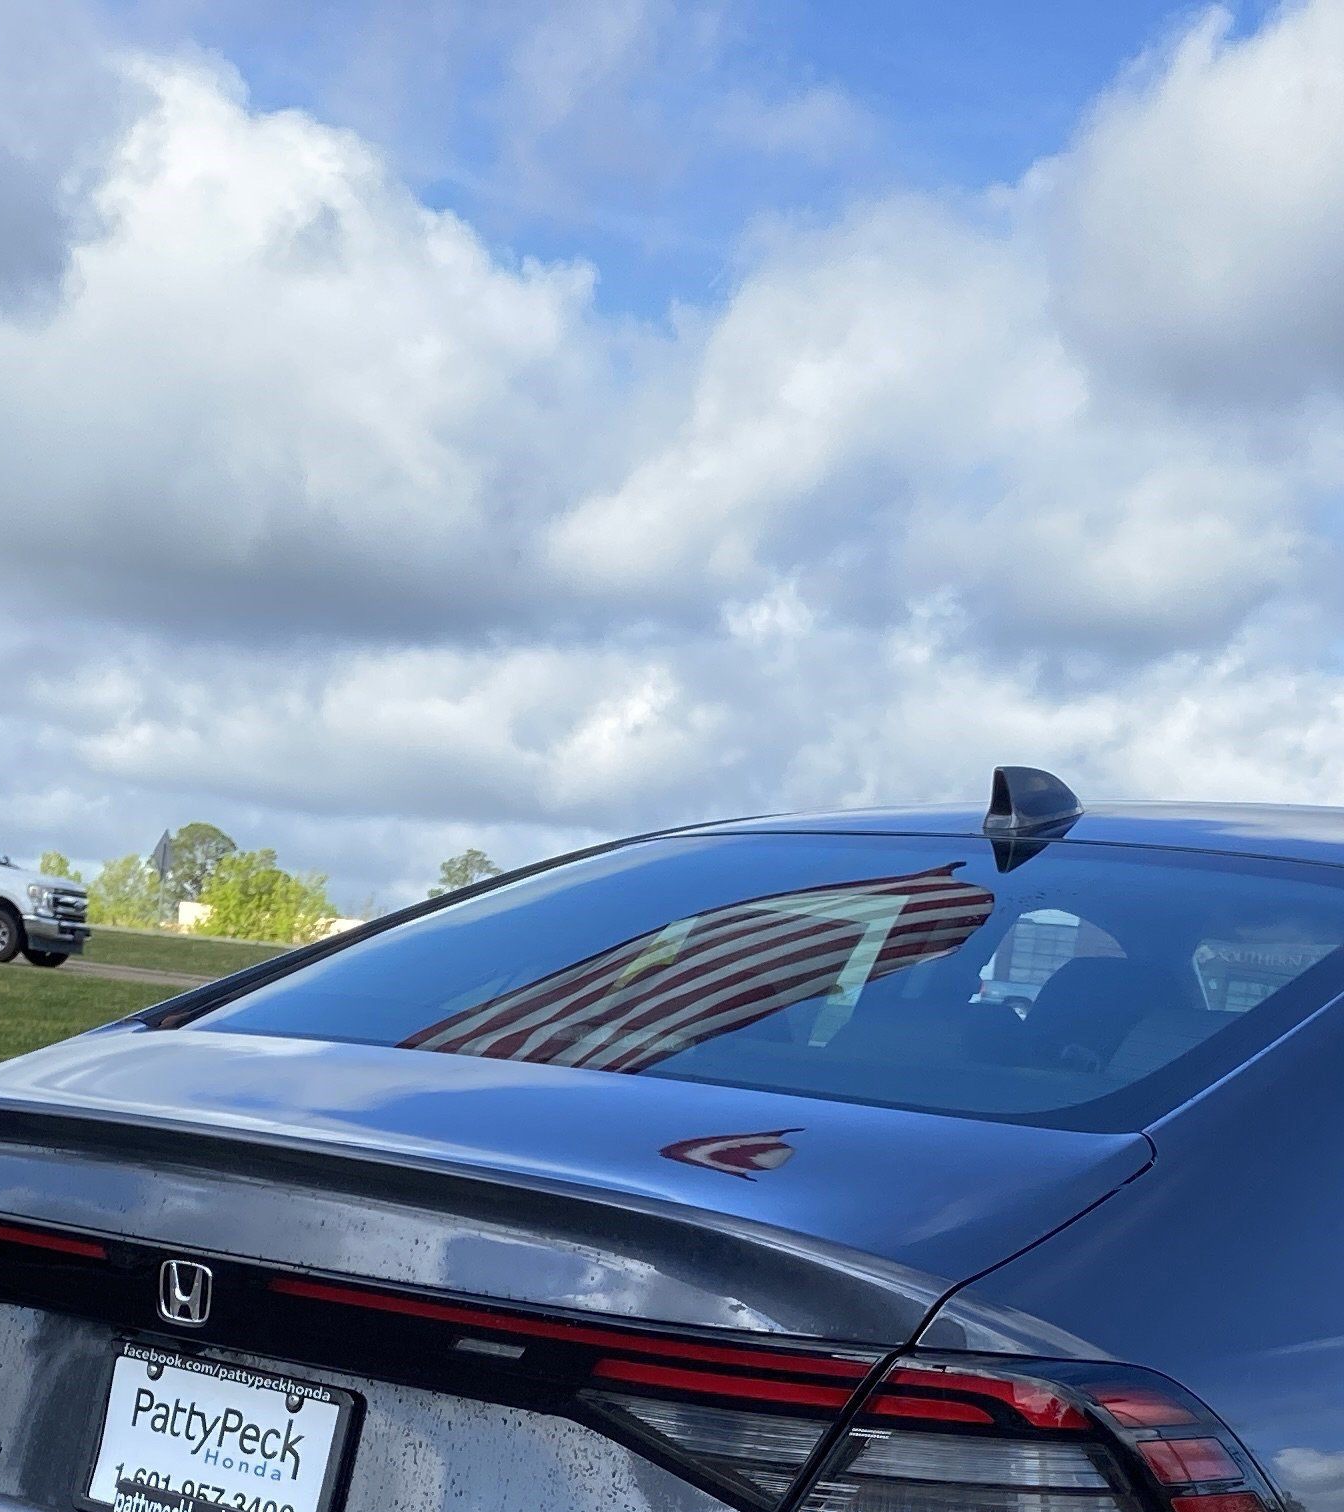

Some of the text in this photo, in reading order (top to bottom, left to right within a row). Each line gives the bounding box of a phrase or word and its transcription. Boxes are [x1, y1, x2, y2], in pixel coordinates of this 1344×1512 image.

[123, 1343, 331, 1401] facebook.com/pattypeckhonda
[131, 1388, 305, 1480] PattyPeck
[204, 1448, 282, 1481] Honda
